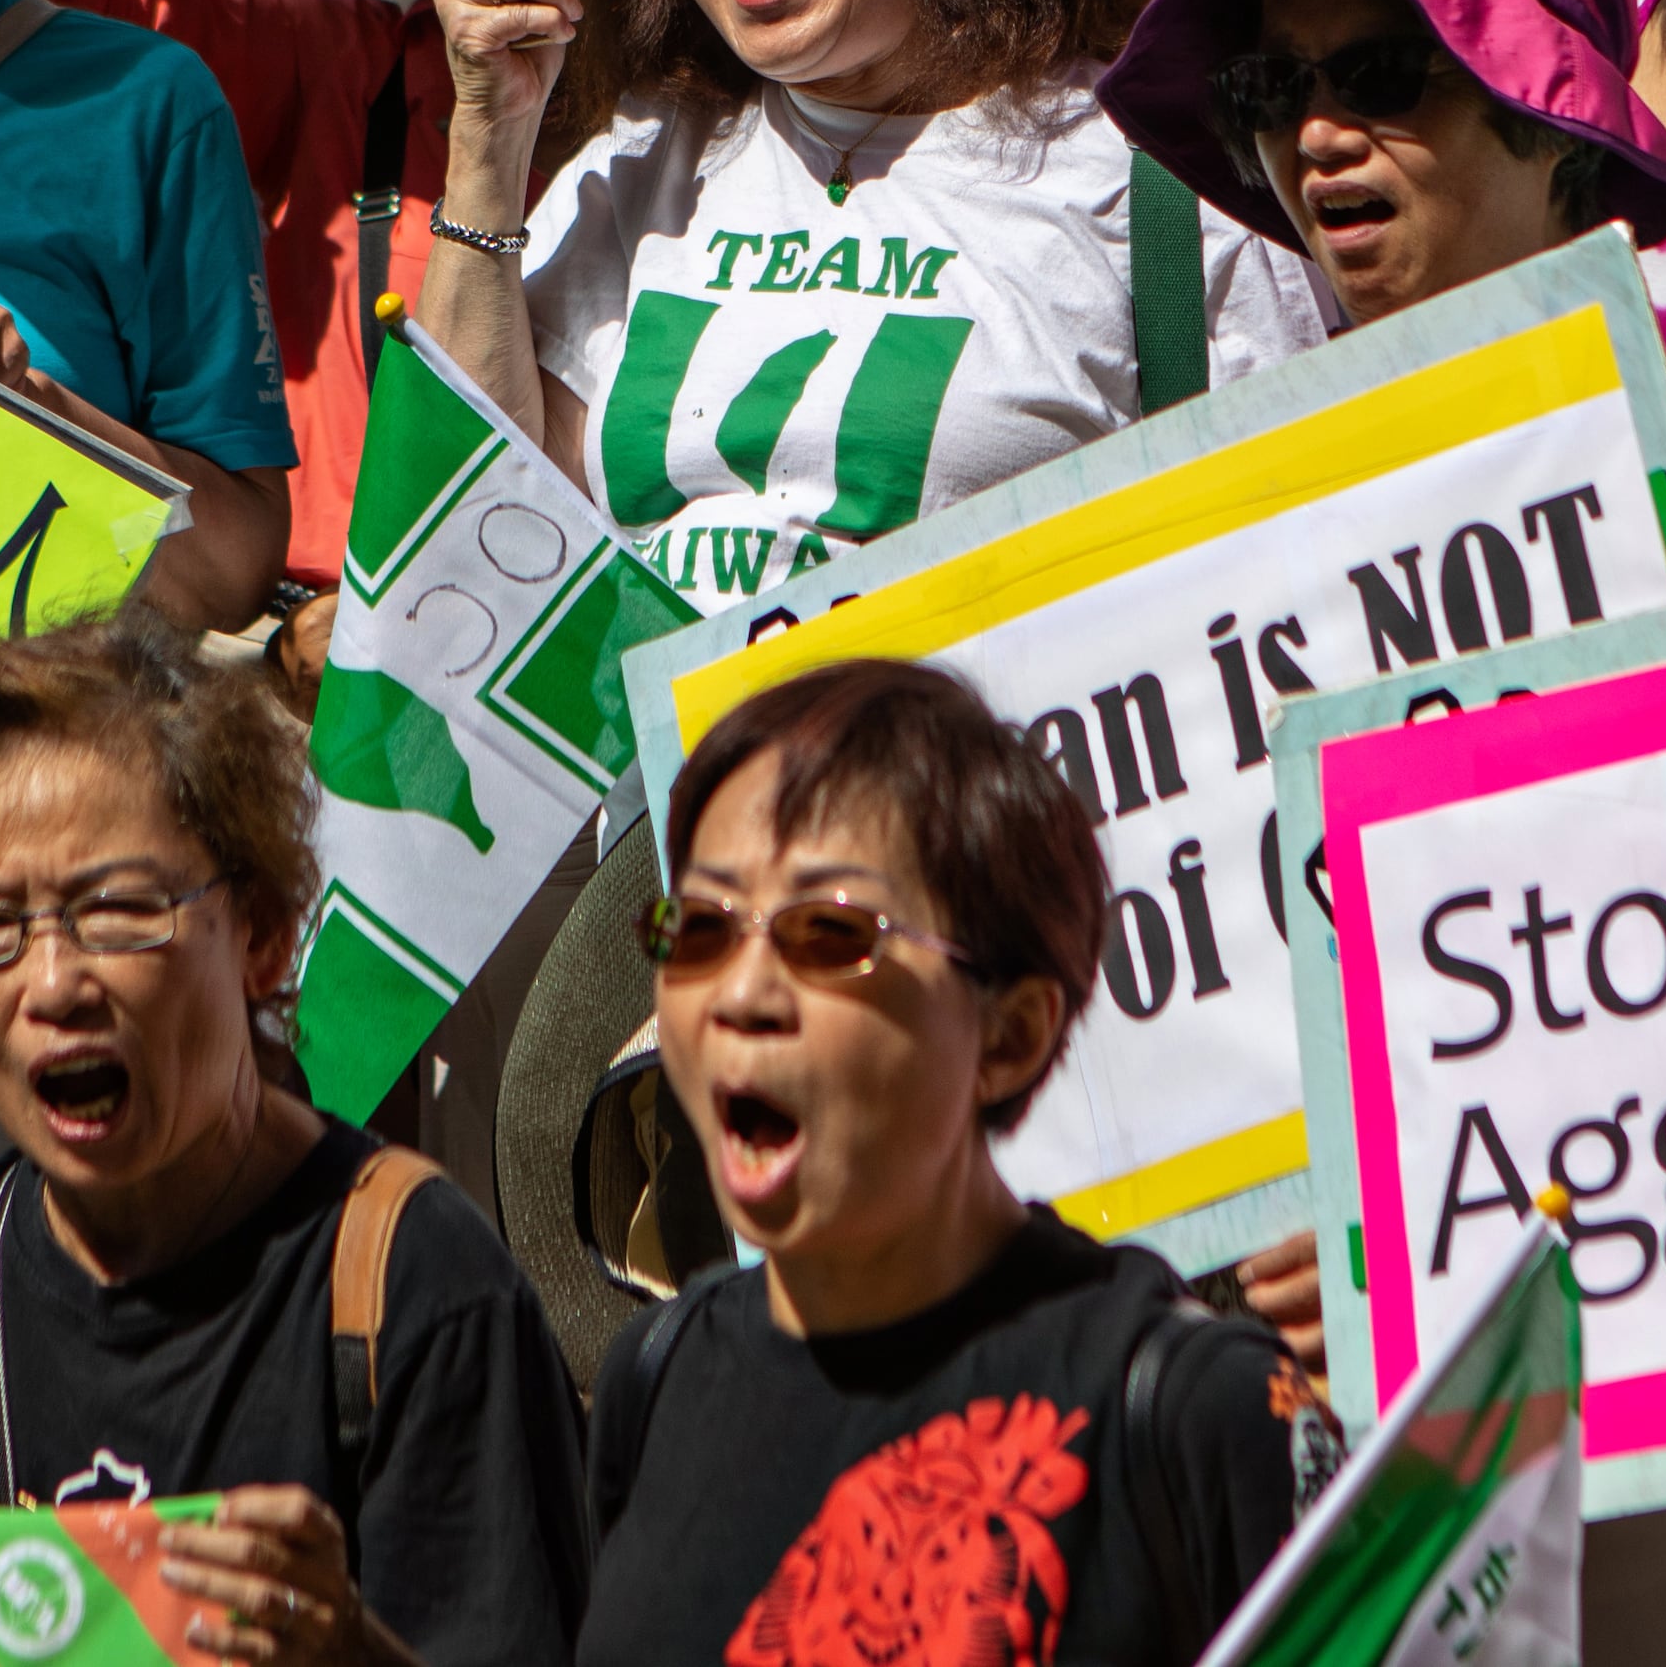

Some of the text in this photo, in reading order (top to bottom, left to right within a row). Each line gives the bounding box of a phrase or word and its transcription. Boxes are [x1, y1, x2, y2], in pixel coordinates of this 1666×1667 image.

[705, 229, 959, 300] TEAM
[632, 526, 832, 597] AIWA
[1346, 484, 1603, 675] NOT
